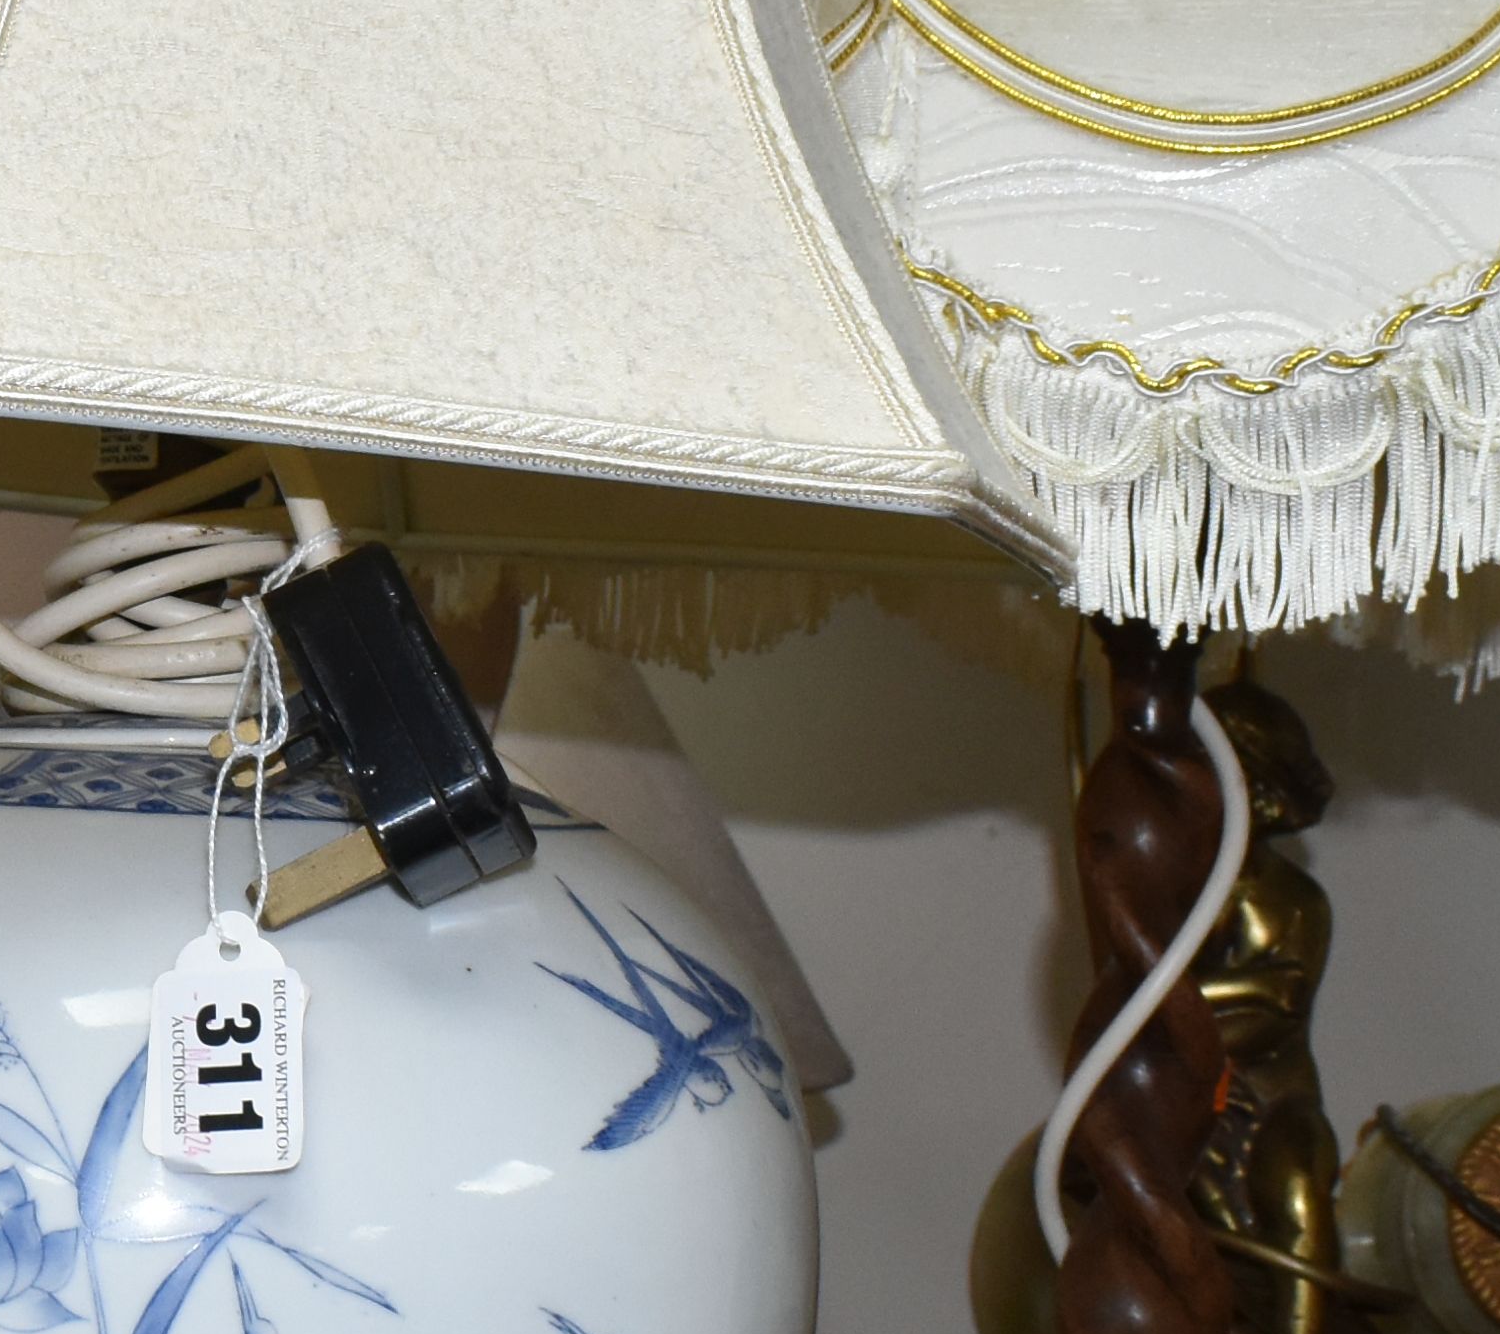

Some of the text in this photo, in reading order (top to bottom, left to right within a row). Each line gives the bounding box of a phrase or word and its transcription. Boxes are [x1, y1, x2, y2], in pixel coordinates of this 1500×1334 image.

[171, 1016, 189, 1136] AUCTIONEERS
[196, 1003, 264, 1133] 311
[272, 979, 290, 1162] RICHARD WINTERTON
